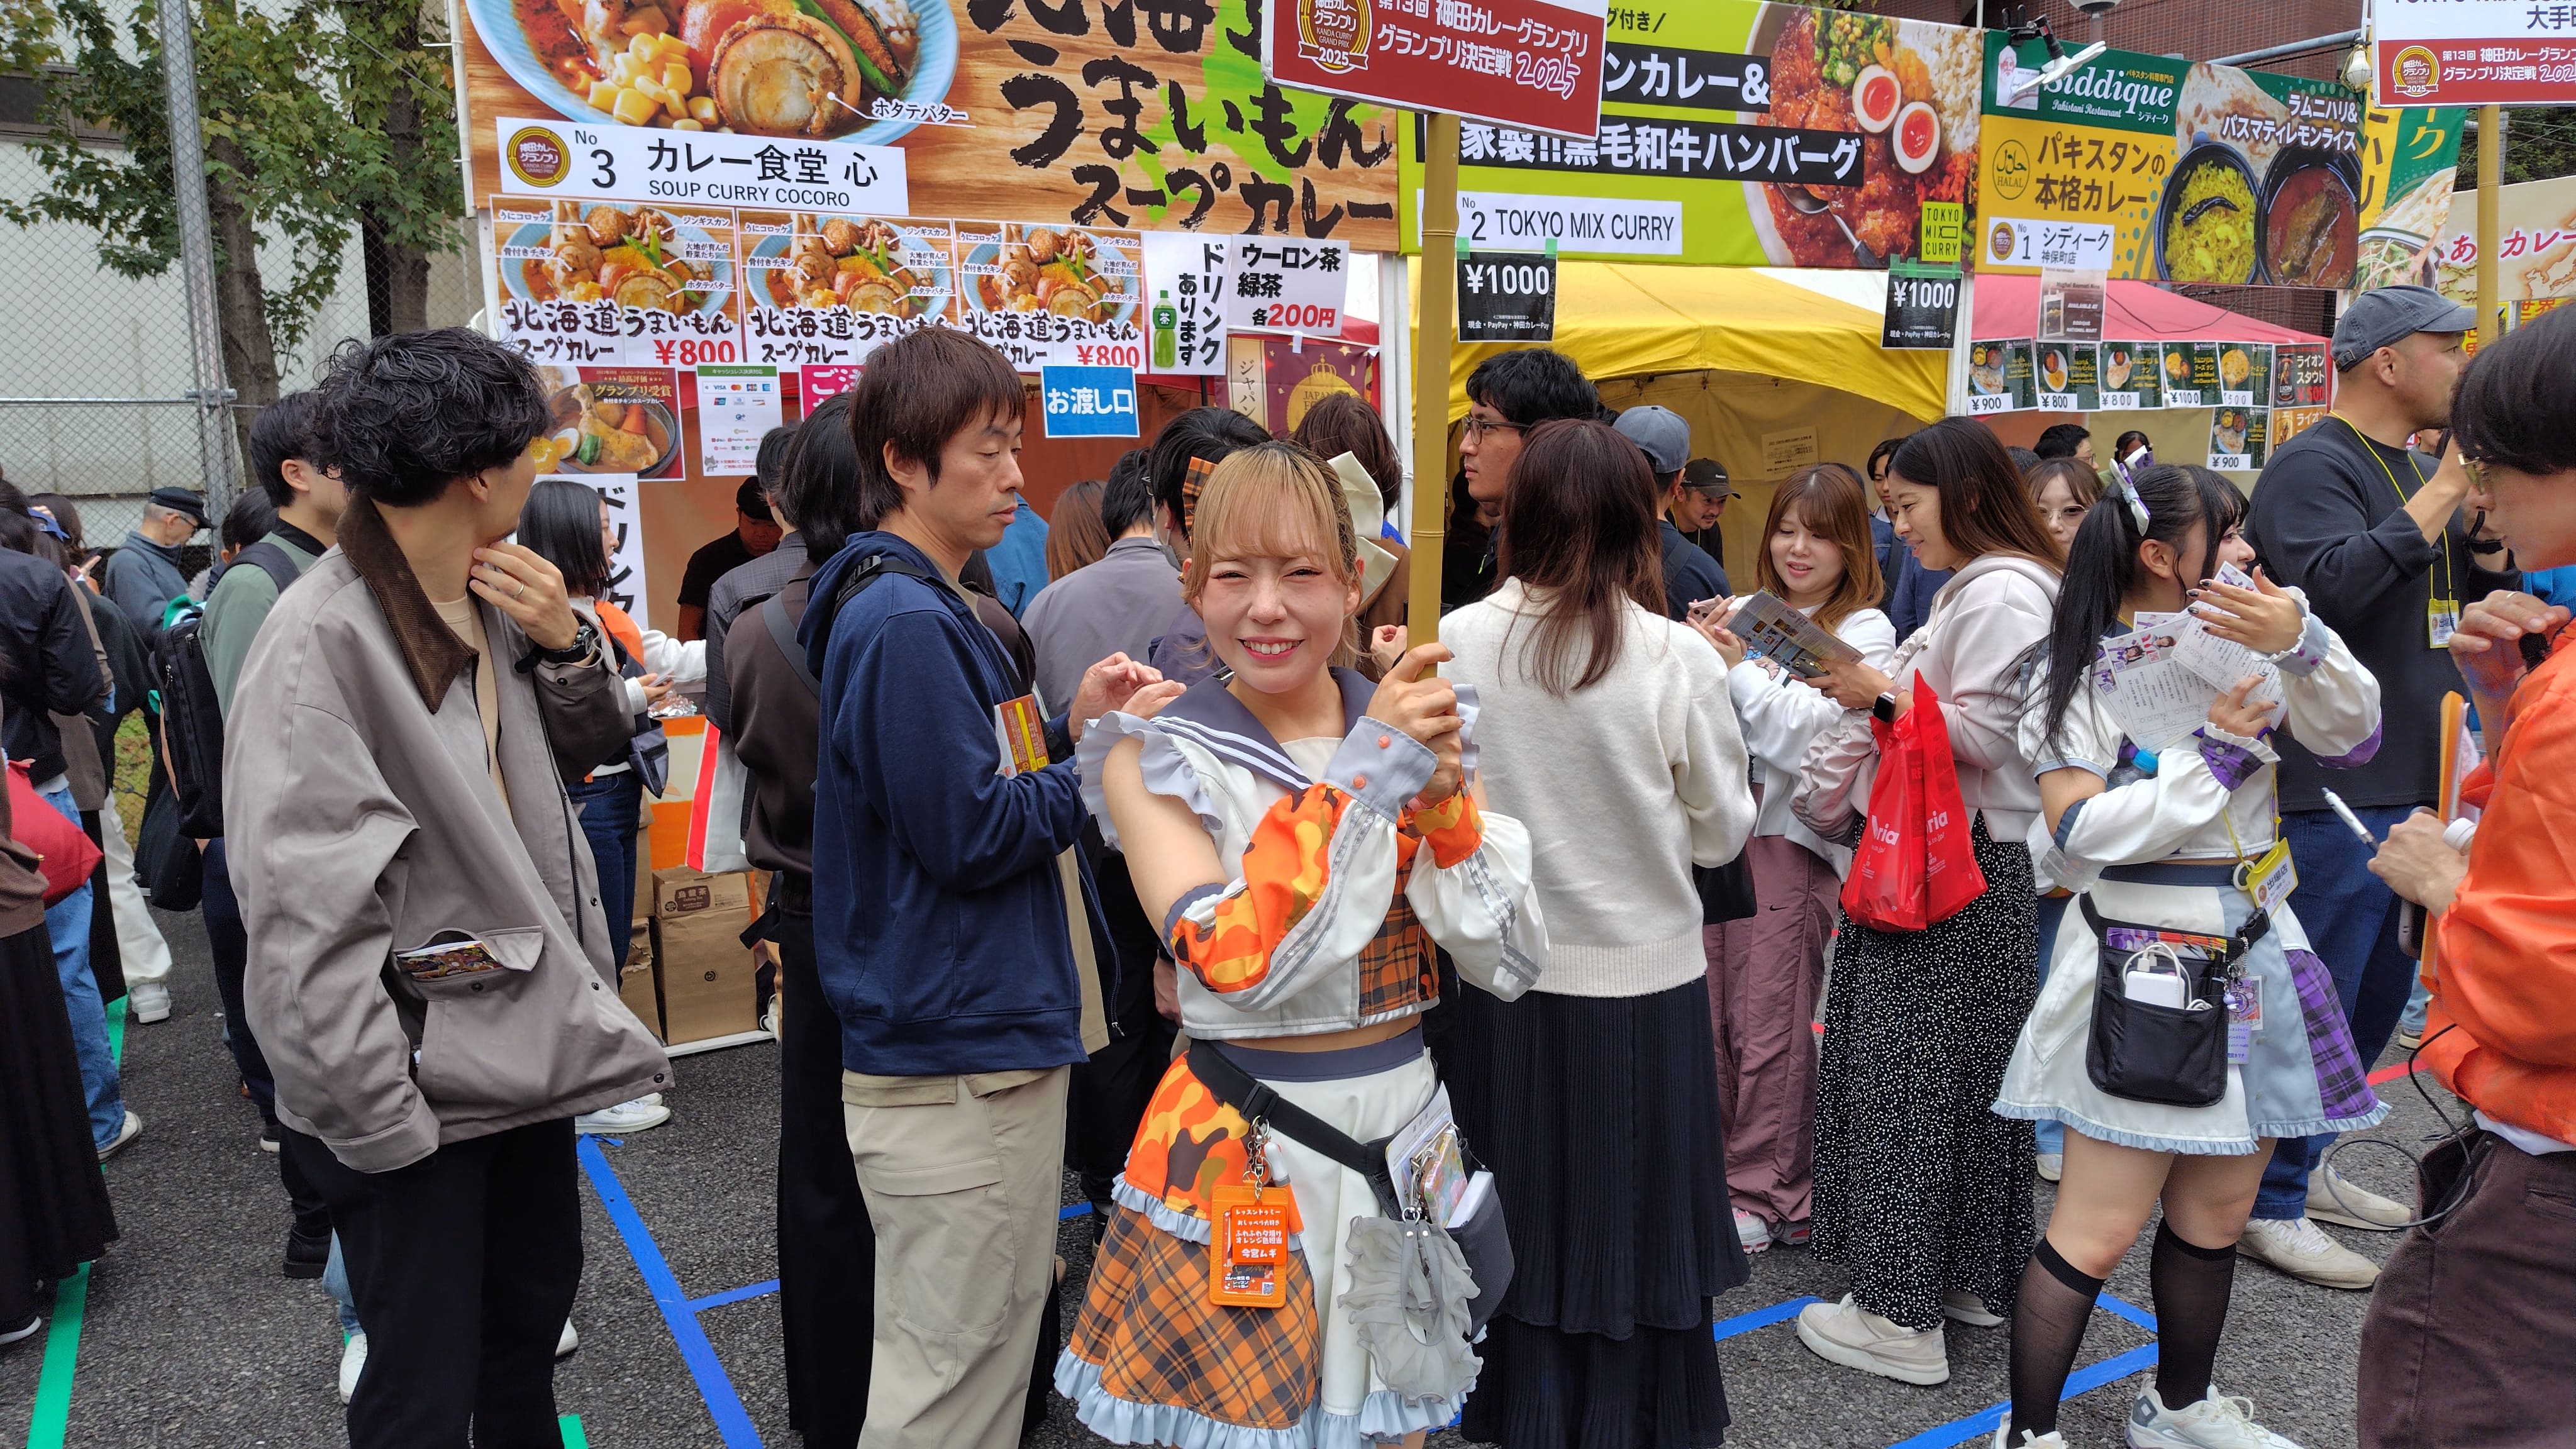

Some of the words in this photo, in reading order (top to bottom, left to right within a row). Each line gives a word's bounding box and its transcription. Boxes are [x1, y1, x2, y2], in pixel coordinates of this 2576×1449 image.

[1314, 10, 1357, 31] グランプリ
[1316, 28, 1335, 38] KANDA
[1335, 32, 1353, 41] CURRY
[1435, 0, 1589, 58] 神田カレーグランプリ
[1319, 36, 1338, 46] GRAND
[1338, 40, 1350, 48] PRIX
[1319, 47, 1350, 65] 2025
[1377, 23, 1513, 79] グランプリ決定戦
[2443, 50, 2476, 61] 第13回
[2480, 47, 2576, 62] 神田カレーグラン
[1516, 52, 1581, 101] 2025
[2443, 66, 2537, 81] グランプリ決定戦
[2539, 64, 2576, 82] 202
[874, 100, 967, 123] ホタテバター
[1001, 39, 1393, 169] うまいもん
[2052, 99, 2084, 113] Pakistani
[2085, 103, 2121, 118] Restaurant
[2289, 94, 2358, 123] ラムニハリ&
[2138, 111, 2169, 125] シディーク
[574, 130, 597, 145] No
[2222, 115, 2357, 152] バスマティレモンライス
[1424, 116, 1862, 180] 家製!!黒毛和牛ハンバーグ
[2037, 131, 2165, 176] パキスタンの
[590, 149, 616, 189] 3
[647, 138, 830, 185] カレー食堂
[844, 152, 879, 187] 心
[1997, 176, 2023, 188] HALAL
[649, 180, 701, 197] SOUP
[708, 184, 769, 202] CURRY
[775, 188, 850, 207] COCORO
[1071, 162, 1393, 238] スープカレー
[2035, 173, 2148, 213] 本格カレー
[1462, 197, 1475, 208] No
[500, 212, 549, 221] うにコロッケ
[683, 216, 729, 226] ジンギスカン
[1927, 208, 1959, 222] TOKYO
[745, 224, 789, 233] うにコロッケ
[907, 228, 947, 236] ジンギスカン
[1472, 211, 1487, 241] 2
[1496, 209, 1564, 238] TOKYO
[1570, 212, 1605, 239] MIX
[1611, 214, 1674, 241] CURRY
[2018, 223, 2027, 233] No
[960, 233, 997, 242] うにコロッケ
[1102, 237, 1138, 247] ジンギスカン
[2022, 235, 2031, 260] 1
[2043, 226, 2109, 252] シディーク
[504, 248, 555, 258] 骨付きチキン
[686, 243, 730, 252] 大地が育んだ
[1926, 242, 1957, 255] CURRY
[749, 258, 794, 267] 骨付きチキン
[909, 252, 948, 260] 大地が育んだ
[1241, 243, 1341, 273] ウーロン茶
[2041, 250, 2077, 265] 神保町店
[963, 264, 1002, 274] 骨付きチキン
[1104, 260, 1137, 269] 大地が育んだ
[687, 282, 733, 290] ホタテバター
[1237, 272, 1283, 298] 緑茶
[1465, 264, 1550, 295] ¥1000
[911, 287, 952, 295] ホタテバター
[1894, 281, 1955, 309] ¥1000
[1199, 243, 1224, 366] ドリンク
[505, 301, 733, 337] 北海道うまいもん
[1158, 312, 1169, 325] 茶
[1179, 273, 1197, 366] あります
[1252, 303, 1336, 328] 各200円
[965, 311, 1138, 343] 北海道うまいもん
[517, 335, 615, 362] スープカレー
[654, 340, 736, 365] ¥800
[762, 340, 848, 364] スープカレー
[1076, 345, 1140, 369] ¥800
[2297, 355, 2325, 369] ライオン
[2296, 372, 2325, 384] スタウト
[594, 384, 672, 397] グランプリ受賞
[1239, 359, 1257, 418] ジャパン
[2280, 385, 2292, 393] LION
[2297, 386, 2324, 402] ¥500
[1047, 386, 1135, 415] お渡し口
[1972, 397, 2002, 411] ¥900
[2041, 395, 2068, 409] ¥800
[2101, 394, 2132, 406] ¥800
[2170, 392, 2200, 404] ¥1000
[2212, 456, 2239, 468] ¥900
